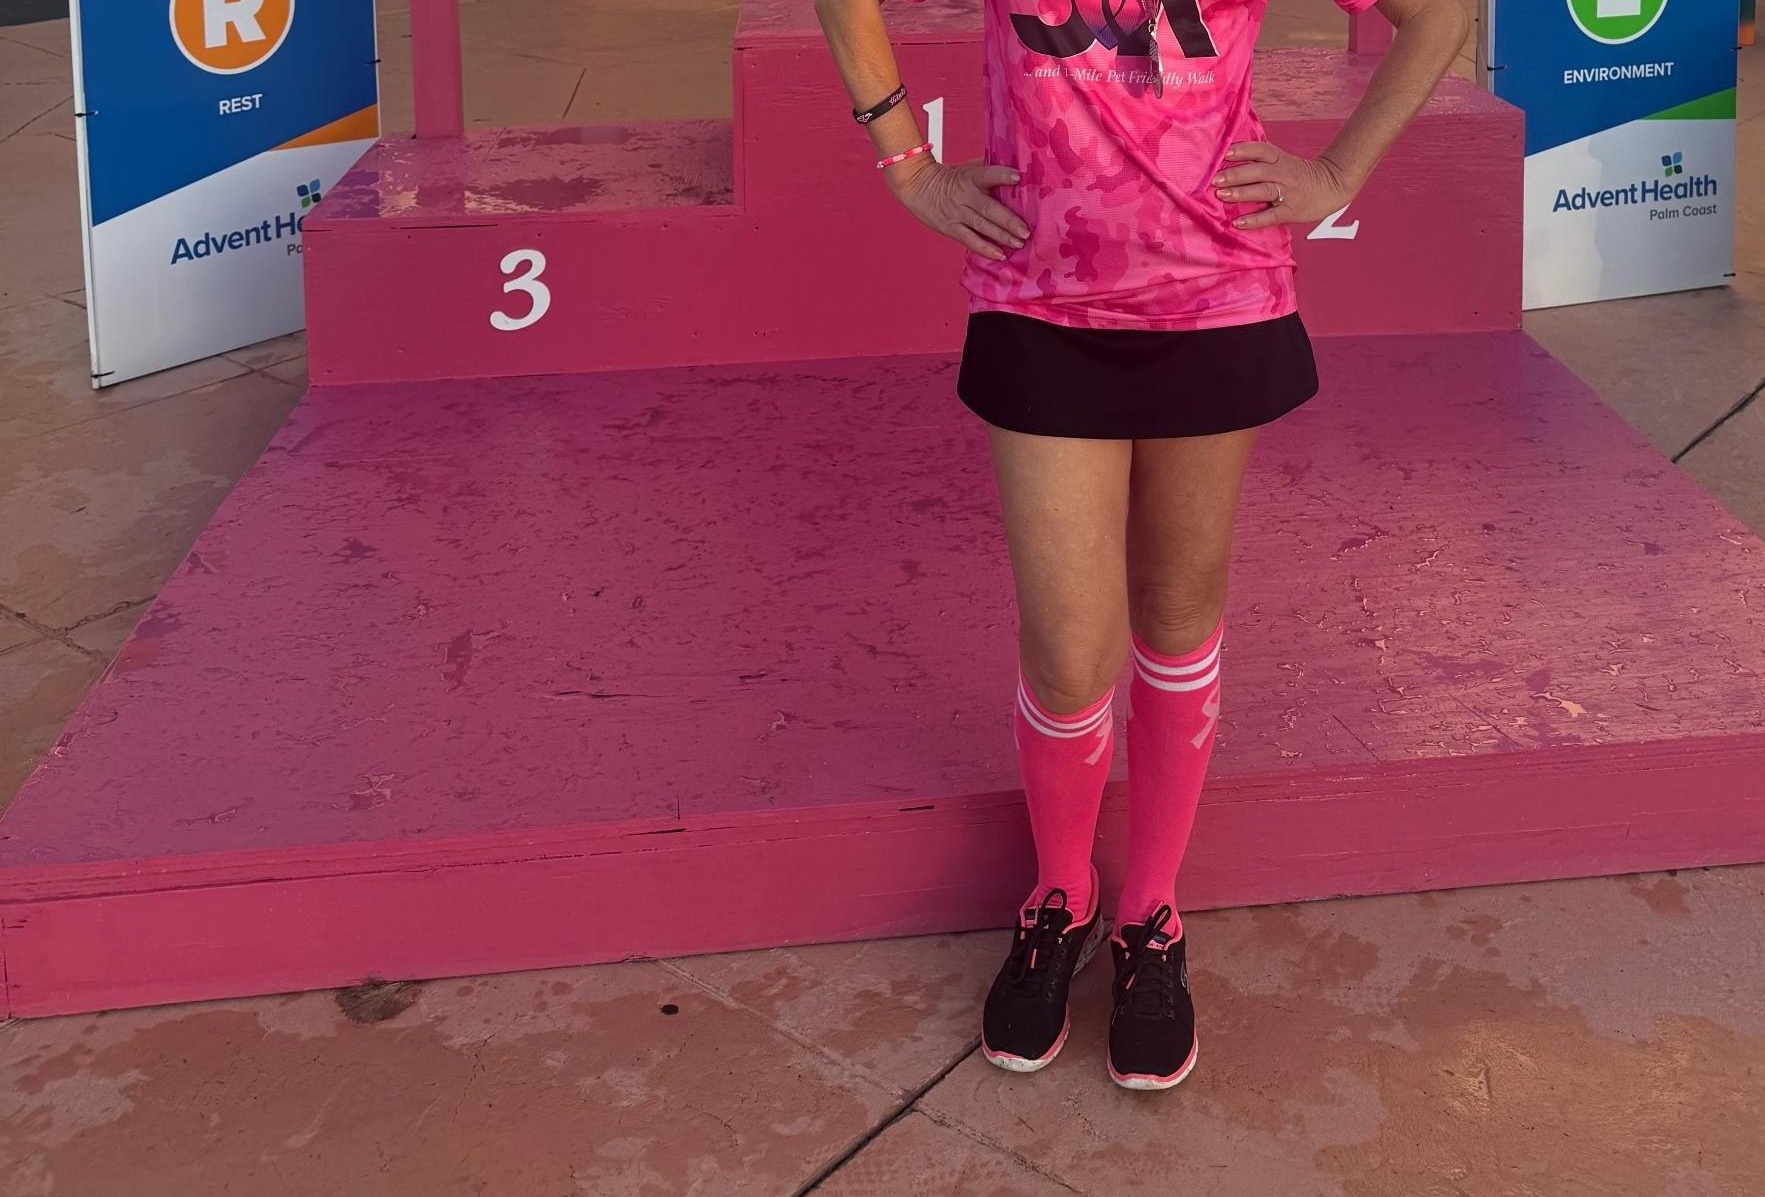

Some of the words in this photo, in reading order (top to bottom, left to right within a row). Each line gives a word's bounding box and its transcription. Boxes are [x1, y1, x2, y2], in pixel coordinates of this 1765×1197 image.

[1035, 65, 1061, 79] and
[1107, 69, 1126, 83] Pet
[1129, 70, 1183, 89] Friedly
[1187, 71, 1215, 84] Walk
[1563, 62, 1674, 84] ENVIRONMENT
[218, 94, 263, 116] REST
[922, 97, 944, 165] 1
[1552, 175, 1717, 213] AdventHealth
[1650, 207, 1679, 221] Palm
[1683, 204, 1717, 217] Coast
[489, 248, 551, 332] 3
